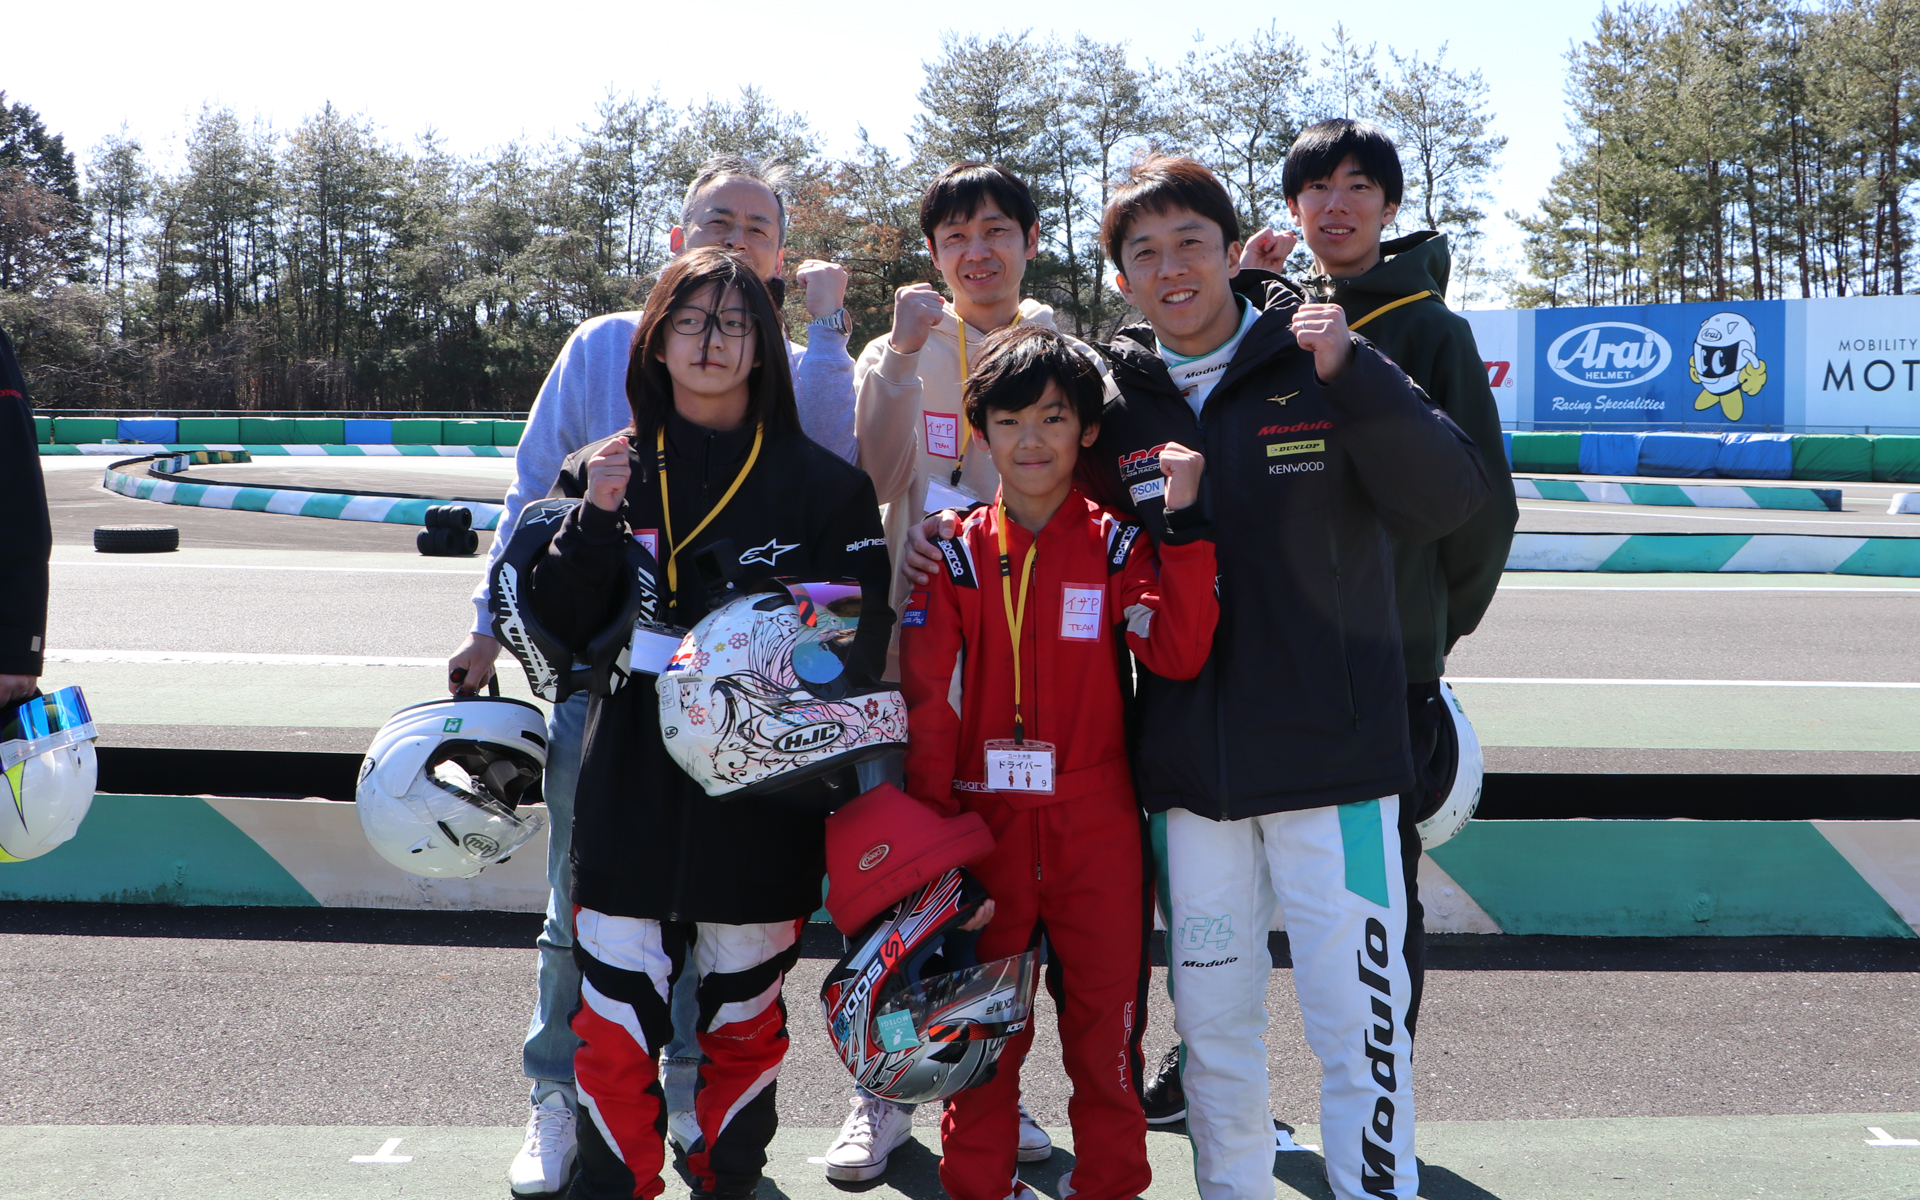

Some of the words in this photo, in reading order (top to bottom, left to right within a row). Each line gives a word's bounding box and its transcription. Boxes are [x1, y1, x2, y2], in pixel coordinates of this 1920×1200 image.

[1555, 329, 1657, 370] Arai
[1839, 339, 1918, 351] MOBILITY
[1184, 362, 1230, 379] Modulo
[1585, 371, 1632, 380] HELMET
[1822, 359, 1920, 392] MOT
[1552, 397, 1592, 414] Racing
[1594, 395, 1665, 412] Specialities
[1257, 420, 1334, 436] Modulo
[934, 442, 950, 450] TEAM
[1278, 443, 1320, 452] DUNLOP
[1139, 464, 1161, 474] RACIN
[1268, 461, 1325, 475] KENWOOD
[1131, 480, 1160, 495] PSON
[1113, 525, 1138, 565] sparco
[784, 725, 836, 750] HJC
[999, 761, 1042, 770] ドライバー
[953, 780, 989, 792] sparc
[465, 835, 498, 855] Arai
[1181, 956, 1239, 968] Modulo
[881, 1015, 909, 1028] MOTEGI
[1118, 1001, 1134, 1093] THUDER
[1357, 917, 1398, 1200] Modulo
